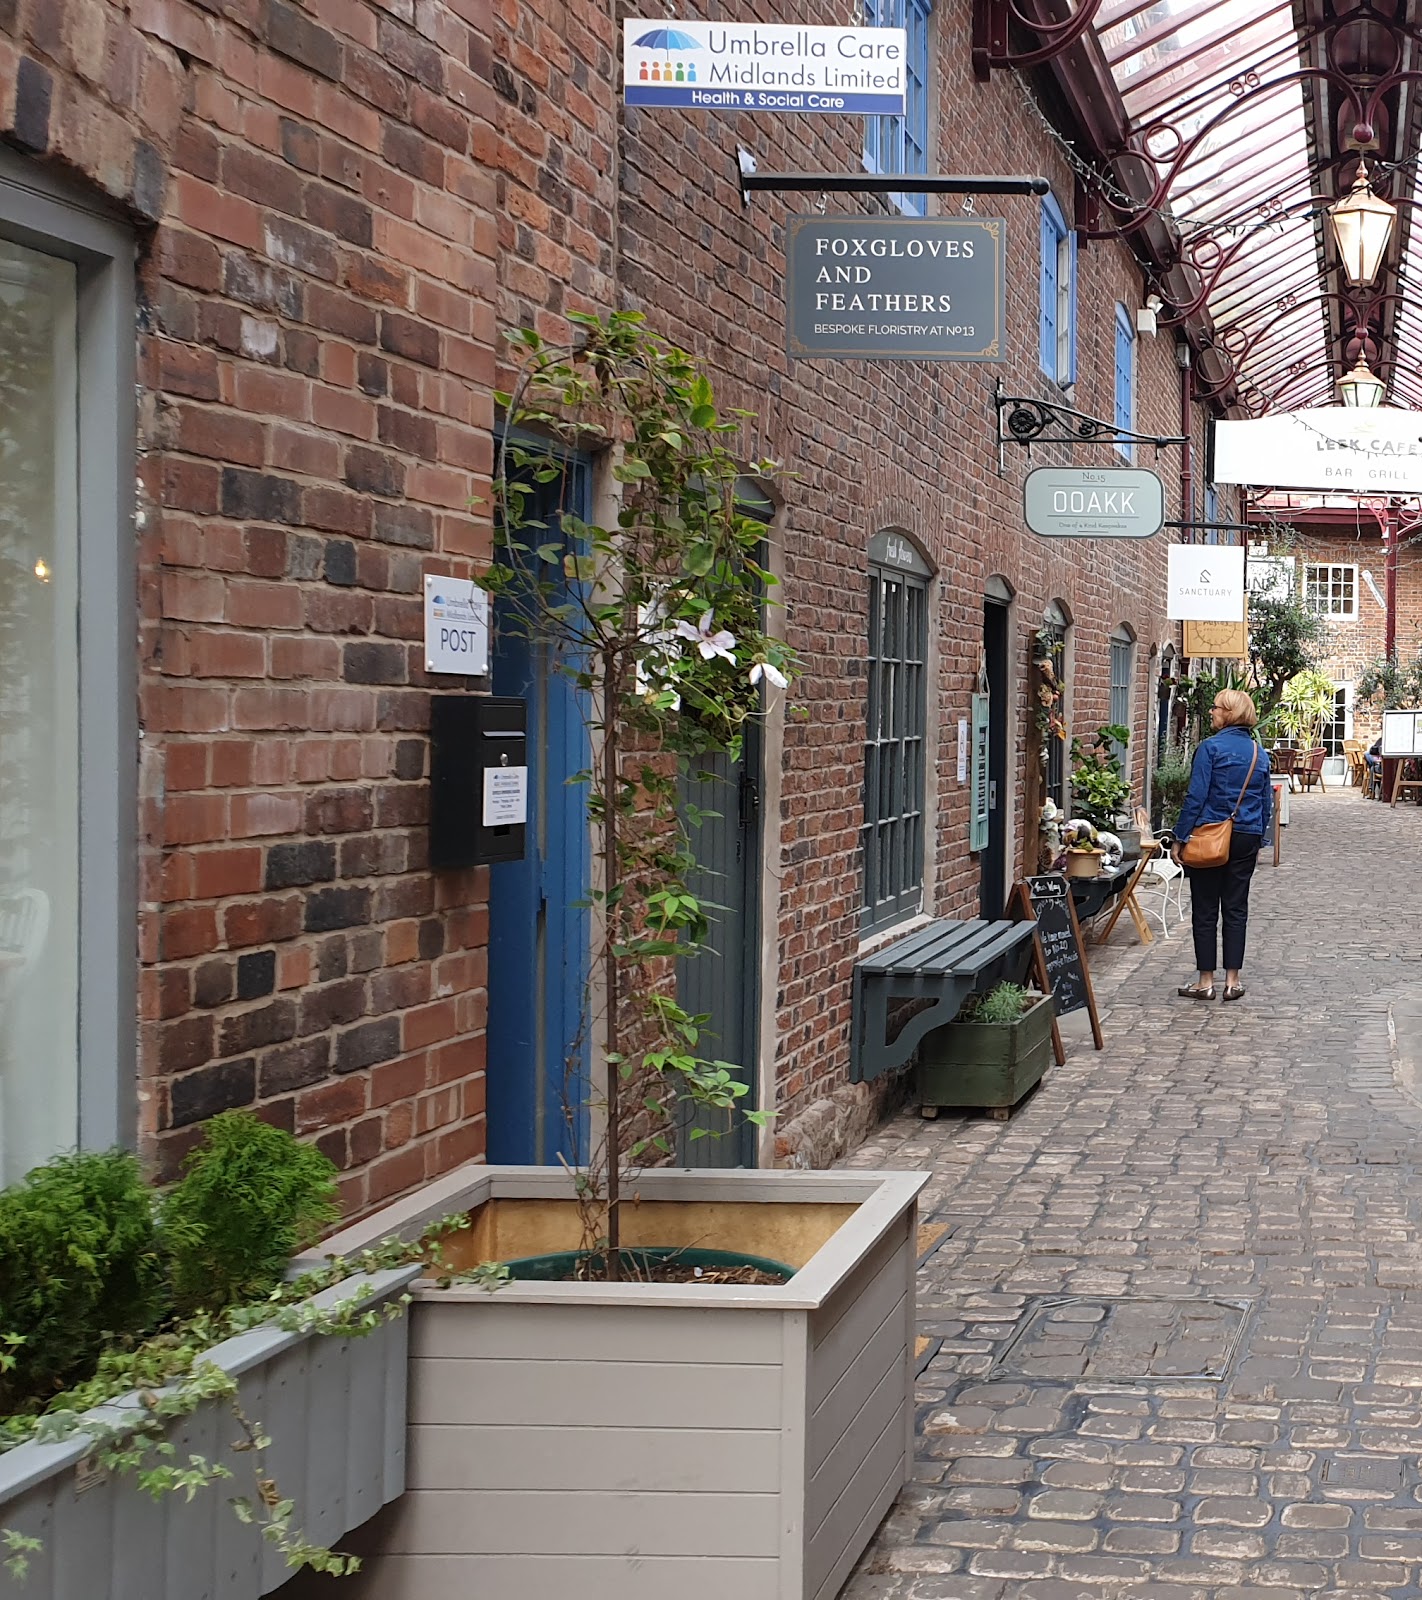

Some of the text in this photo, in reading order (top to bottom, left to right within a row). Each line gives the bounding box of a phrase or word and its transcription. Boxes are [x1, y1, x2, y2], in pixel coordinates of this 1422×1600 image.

[708, 30, 900, 61] Umbrella Care
[709, 62, 900, 90] Midlands Limited
[692, 90, 845, 110] Health & Social Care
[815, 238, 975, 259] FOXGLOVES
[815, 266, 872, 284] AND
[815, 293, 952, 313] FEATHERS
[814, 323, 865, 335] BESPOKE
[868, 323, 928, 336] FLORISTRY
[929, 325, 943, 336] AT
[1316, 439, 1417, 453] LEEK CAFE
[1325, 467, 1409, 480] BAR GRILL
[1053, 490, 1135, 514] OOAKK
[1179, 588, 1232, 596] SANCTUARY
[440, 628, 476, 653] POST
